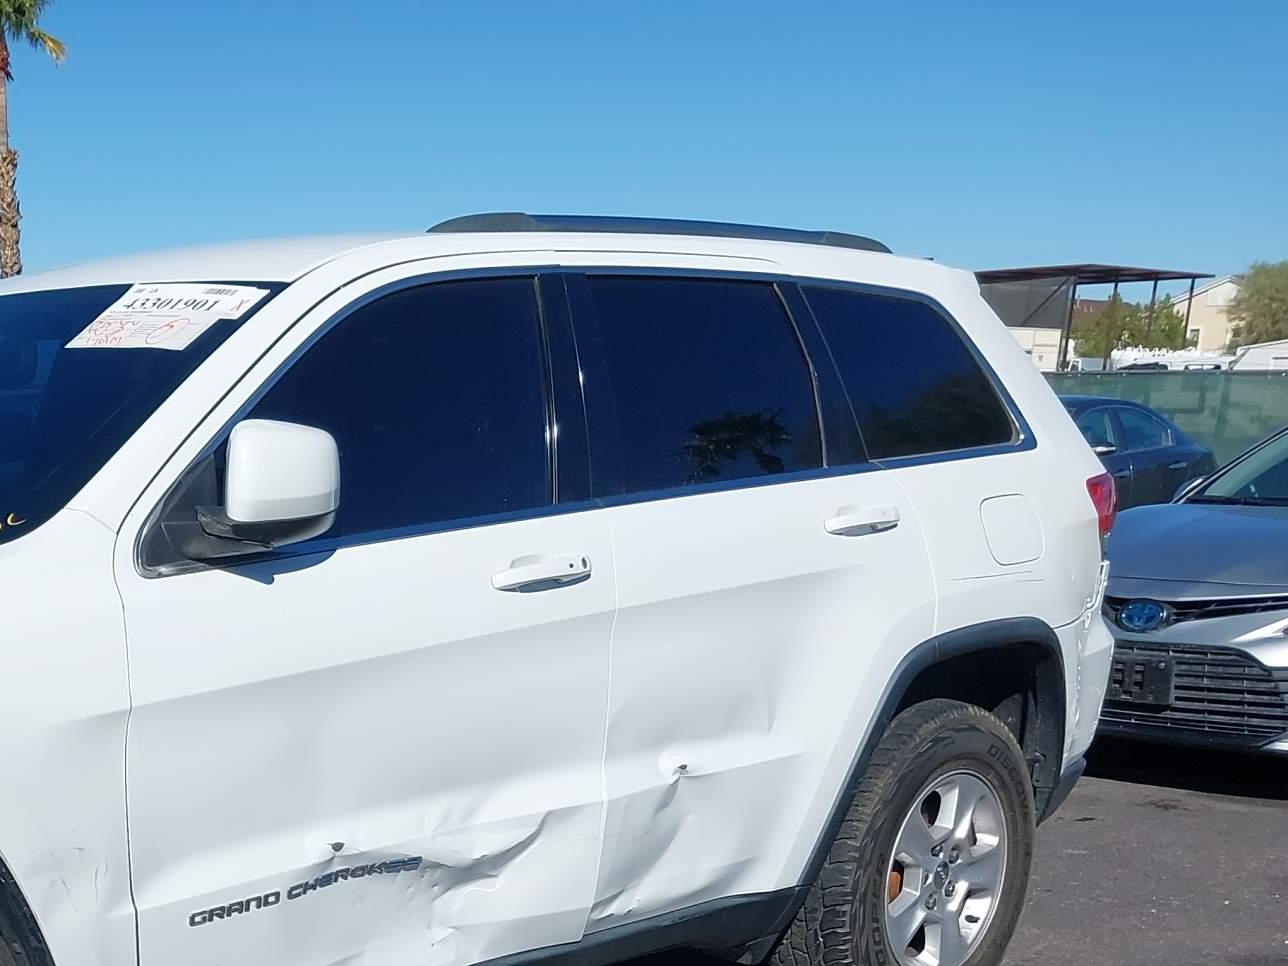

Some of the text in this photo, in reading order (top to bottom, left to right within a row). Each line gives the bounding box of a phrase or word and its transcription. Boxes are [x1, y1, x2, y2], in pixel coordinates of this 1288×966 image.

[123, 297, 222, 313] 43301901
[188, 856, 423, 928] GRAND CHEROKEE
